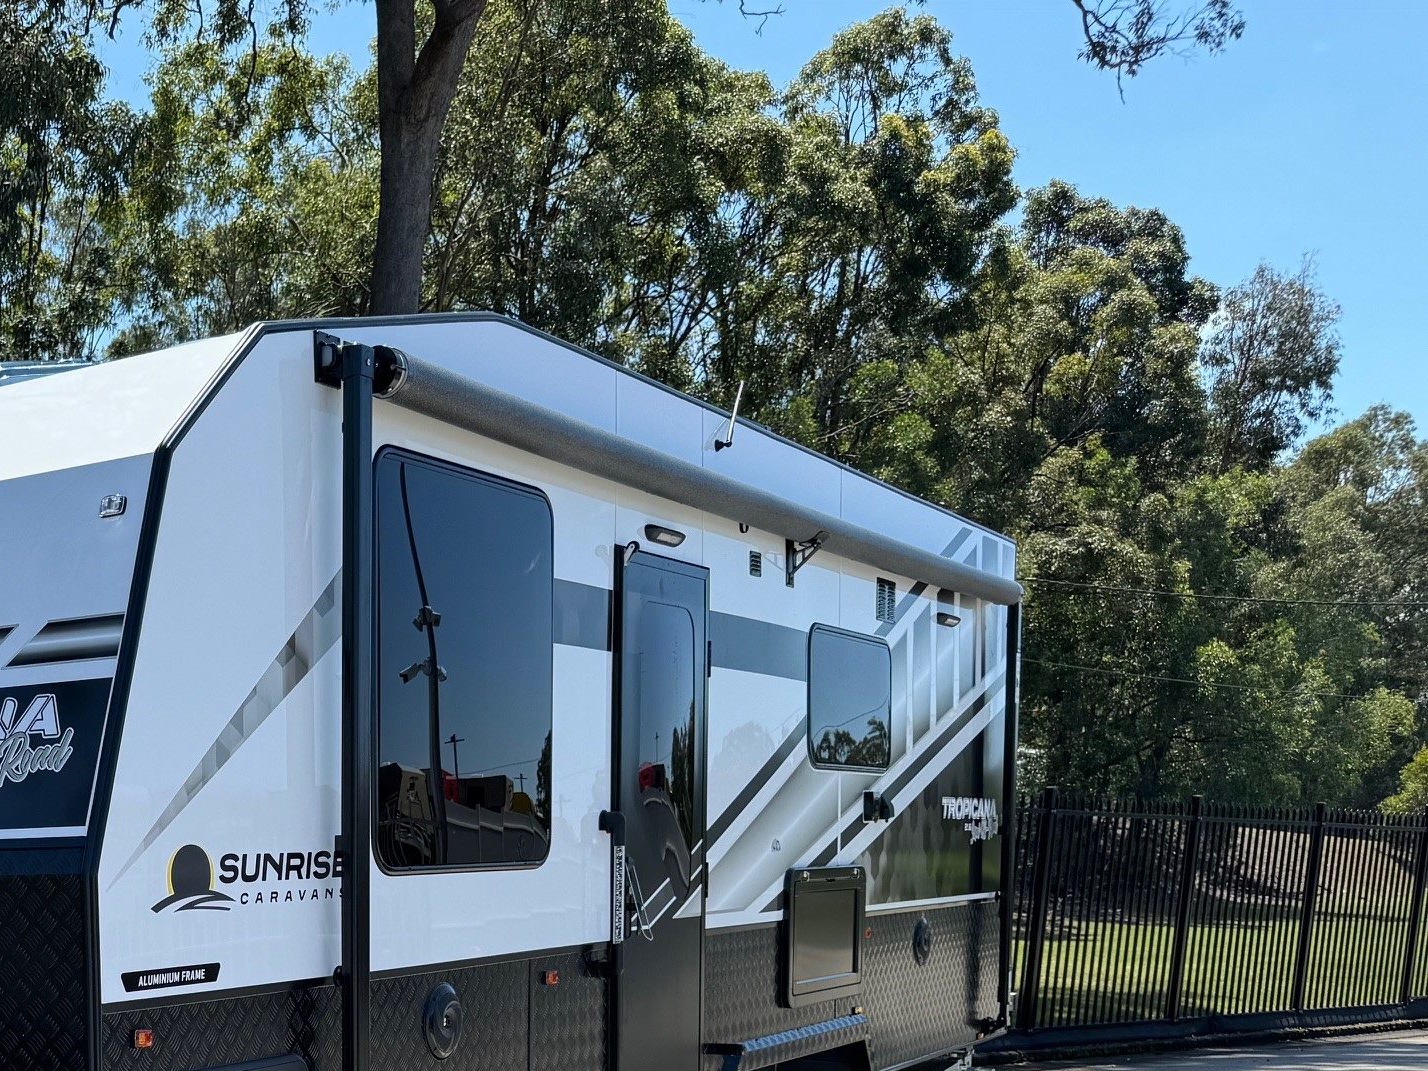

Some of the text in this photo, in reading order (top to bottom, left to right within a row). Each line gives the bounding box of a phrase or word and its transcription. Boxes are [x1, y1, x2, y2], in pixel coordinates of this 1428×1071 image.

[942, 796, 997, 819] TROPICANA
[218, 850, 343, 884] SUNRISE
[138, 968, 206, 987] ALUMINIUM FRAME
